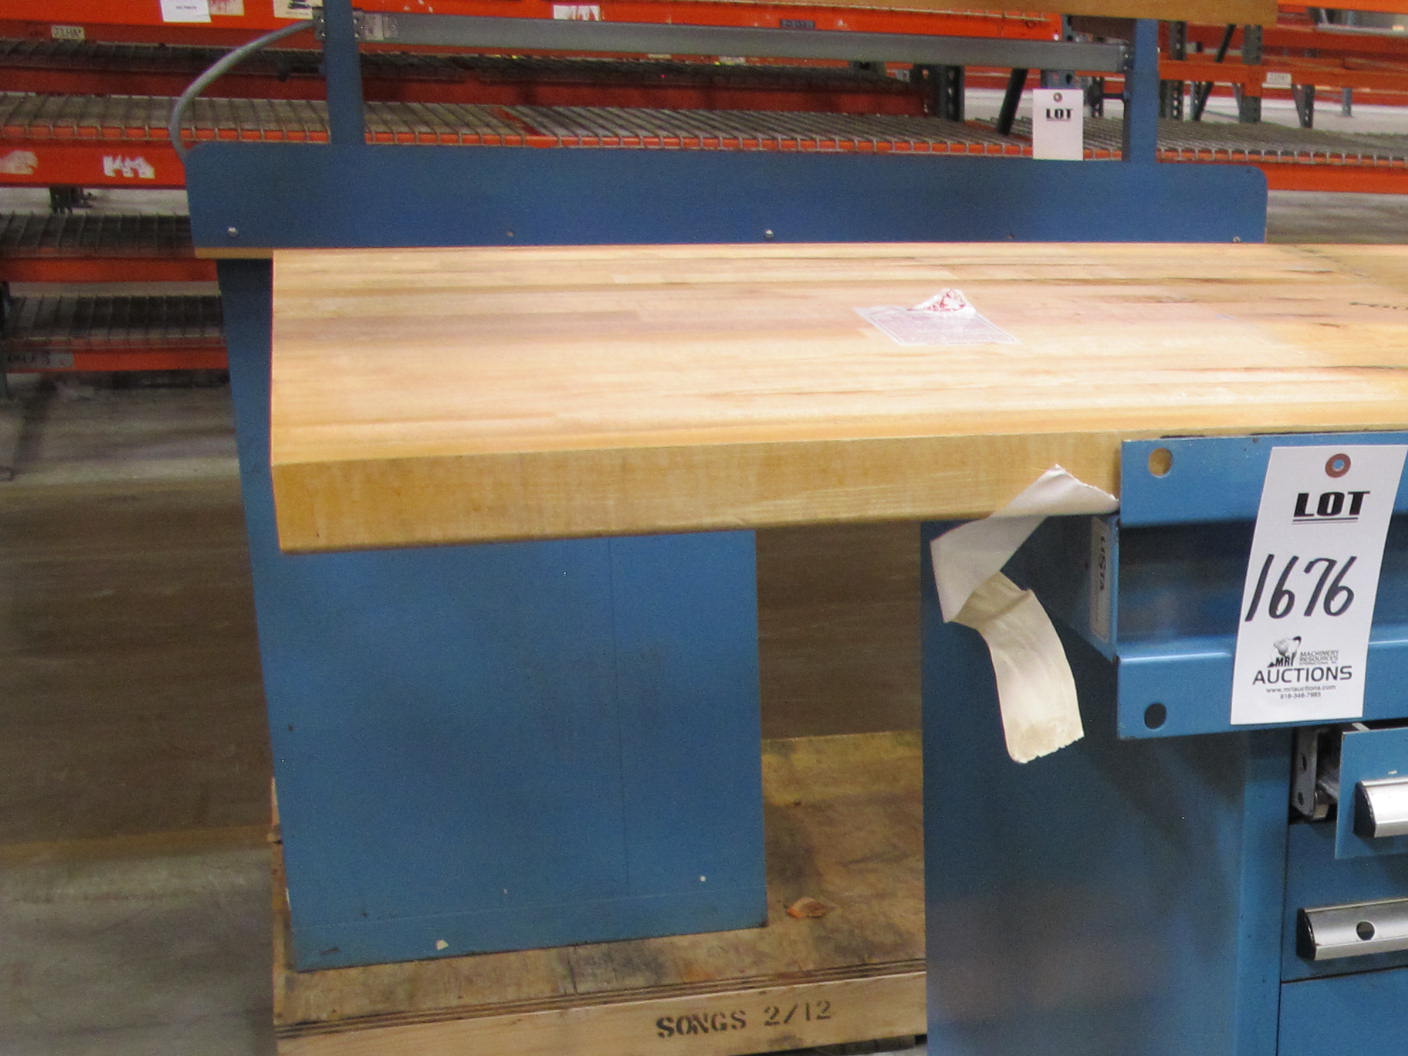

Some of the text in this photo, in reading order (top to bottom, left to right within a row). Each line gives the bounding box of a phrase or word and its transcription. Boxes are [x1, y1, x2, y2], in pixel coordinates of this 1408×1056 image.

[1045, 107, 1073, 119] LOT
[1293, 491, 1371, 518] LOT
[1244, 553, 1358, 622] 1676
[1252, 665, 1353, 685] AUCTIONS
[656, 1000, 832, 1038] SONGS 2/12
